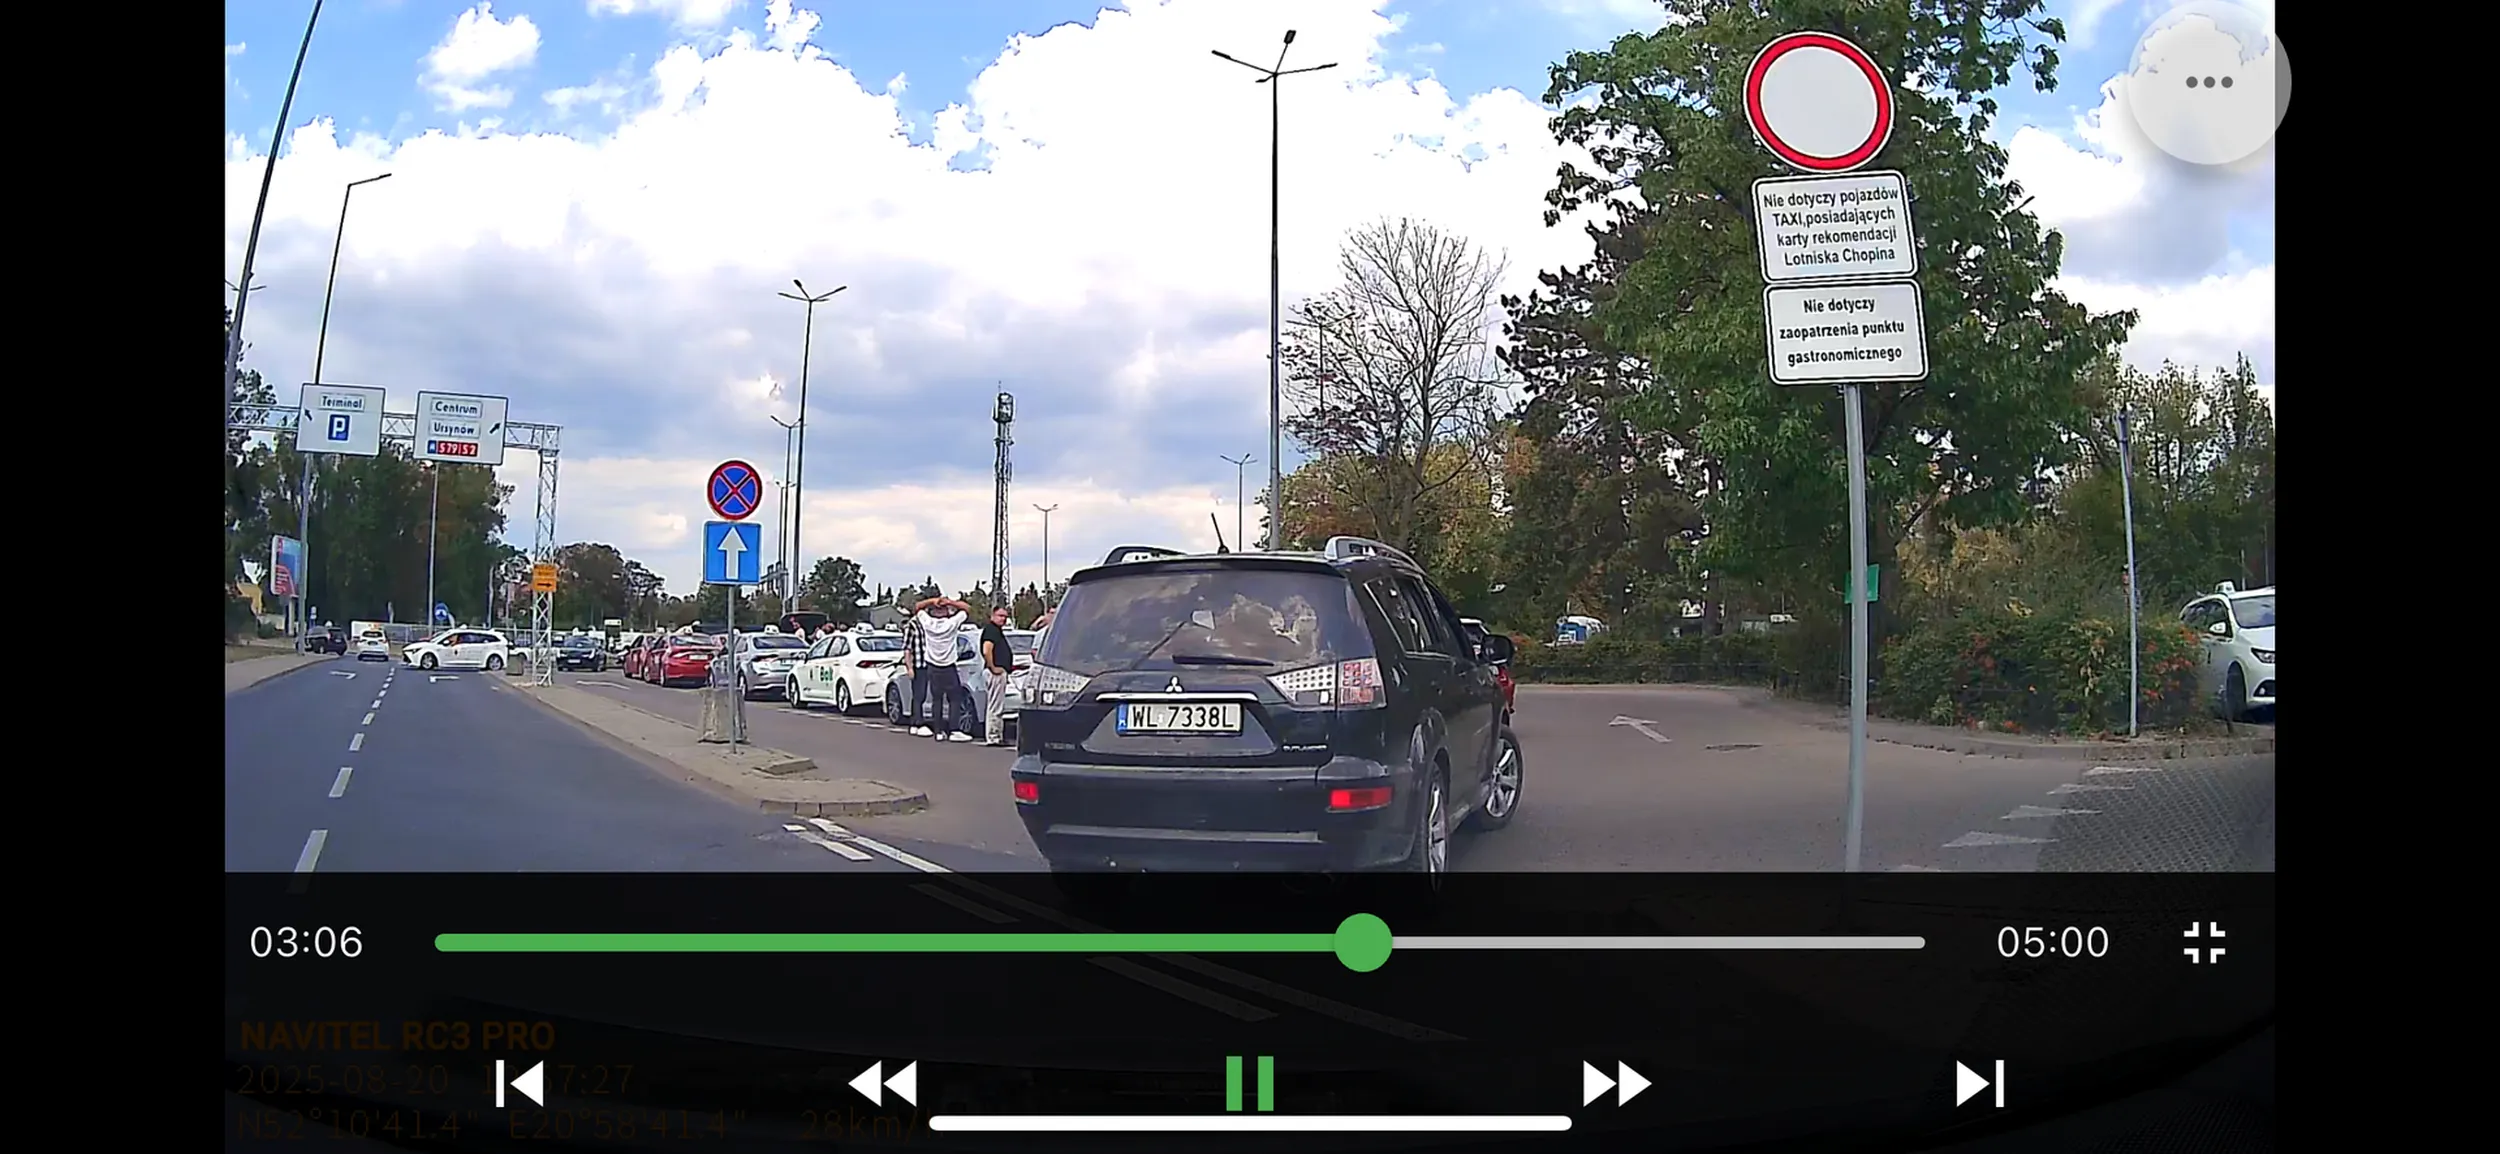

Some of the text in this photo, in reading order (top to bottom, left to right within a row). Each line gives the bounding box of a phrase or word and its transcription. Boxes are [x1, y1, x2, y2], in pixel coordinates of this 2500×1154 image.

[1764, 186, 1899, 209] Nie dotyczy pojazdów
[1772, 206, 1896, 228] TAXI,posiadających
[1776, 226, 1898, 248] karty rekomendacji
[1784, 246, 1896, 266] Lotniska Chopina
[1803, 297, 1876, 314] Nie dotyczy
[1779, 319, 1905, 341] zaopatrzenia punktu
[1787, 347, 1902, 368] gastronomicznego
[322, 395, 363, 409] Terminal
[435, 400, 478, 414] Centrum
[433, 421, 475, 437] Ursynów
[1132, 705, 1234, 728] WL 7338L
